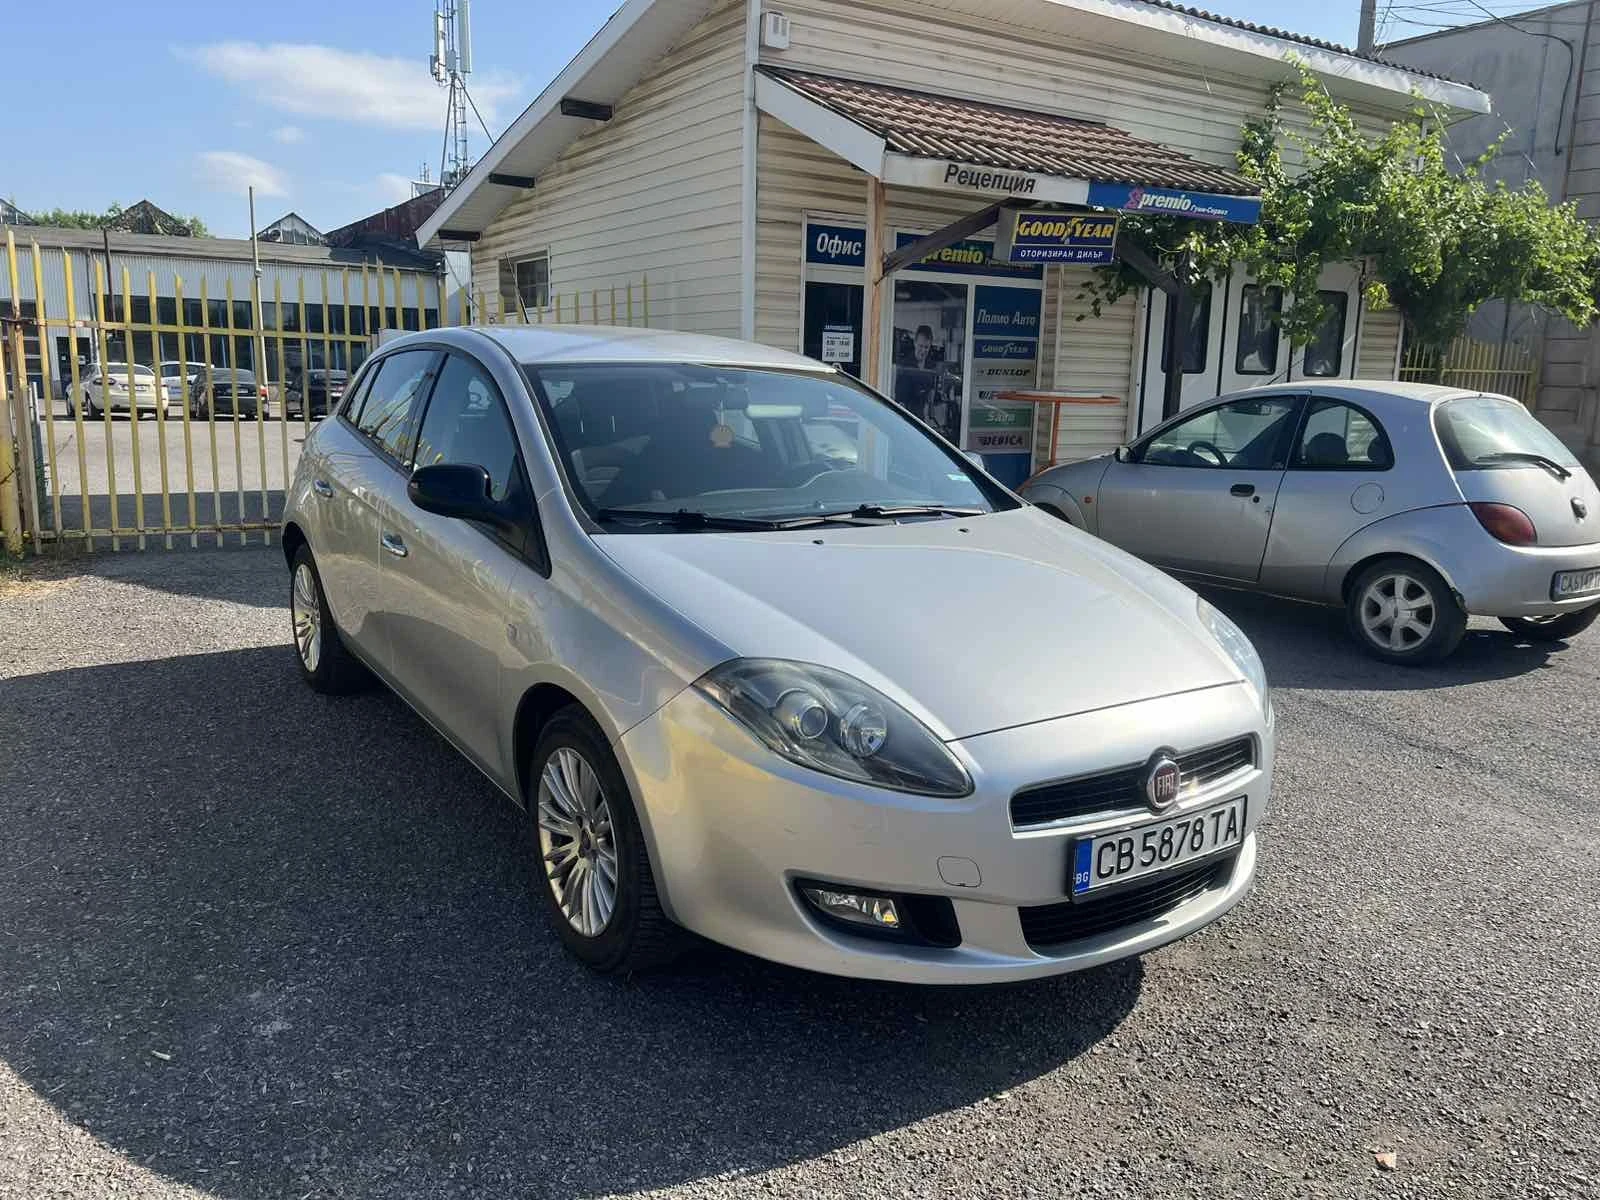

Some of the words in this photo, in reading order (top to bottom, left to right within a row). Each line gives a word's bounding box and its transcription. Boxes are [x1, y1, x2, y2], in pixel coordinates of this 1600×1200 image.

[944, 163, 1036, 194] Рецепция
[1138, 192, 1192, 211] premio
[1019, 218, 1114, 240] GOODYEAR
[816, 232, 862, 258] Офис
[1020, 249, 1074, 258] ОТОРИЗИРАН
[986, 368, 1031, 377] DUNLOP
[1157, 772, 1175, 797] FIAT
[1075, 871, 1090, 885] BG
